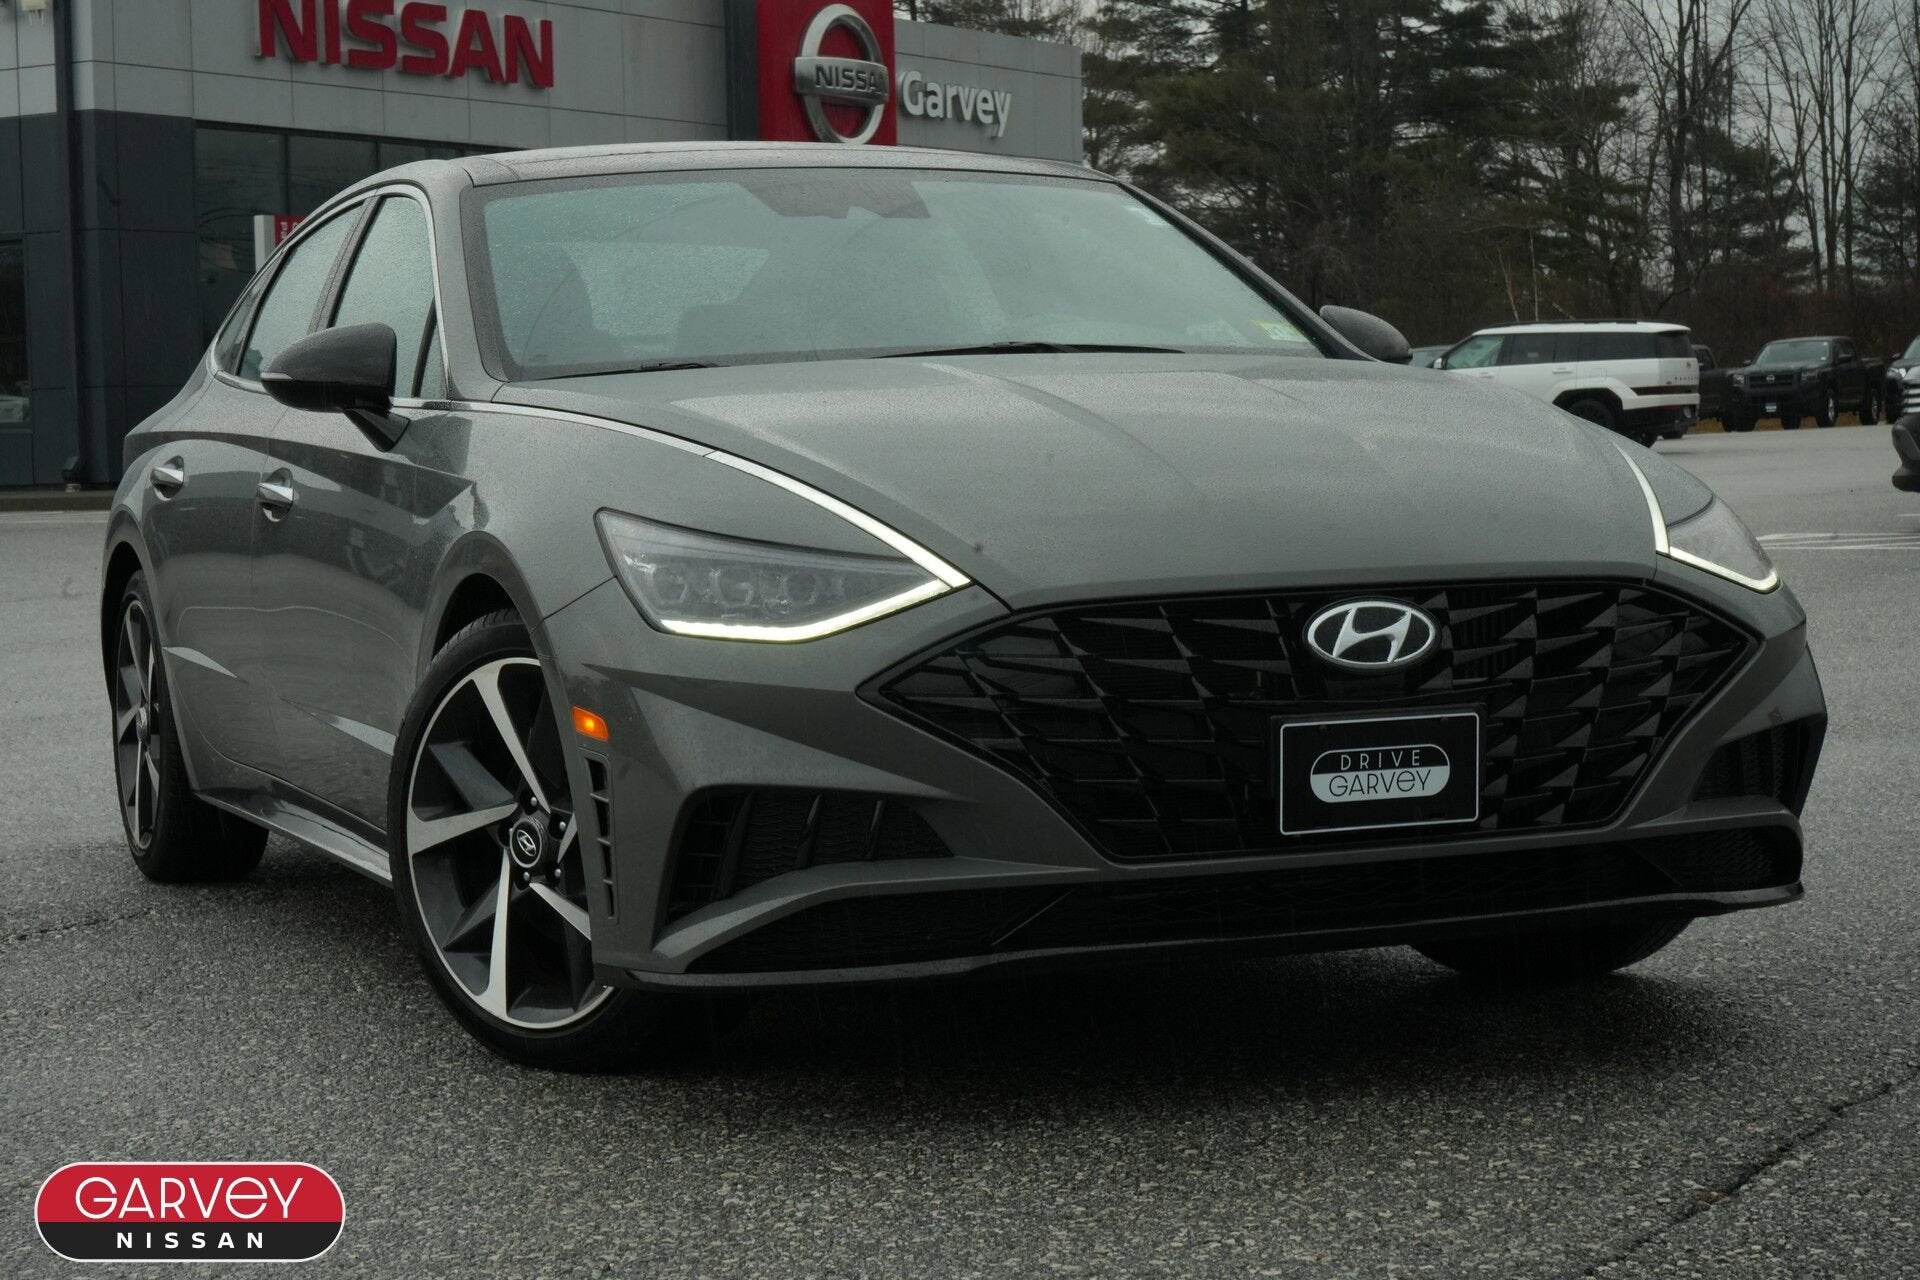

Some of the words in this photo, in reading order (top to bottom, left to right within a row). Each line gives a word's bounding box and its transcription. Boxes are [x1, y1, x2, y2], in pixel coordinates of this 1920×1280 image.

[257, 0, 554, 87] NISSAN
[902, 70, 1011, 138] Garvey
[1340, 750, 1421, 771] DRIVE
